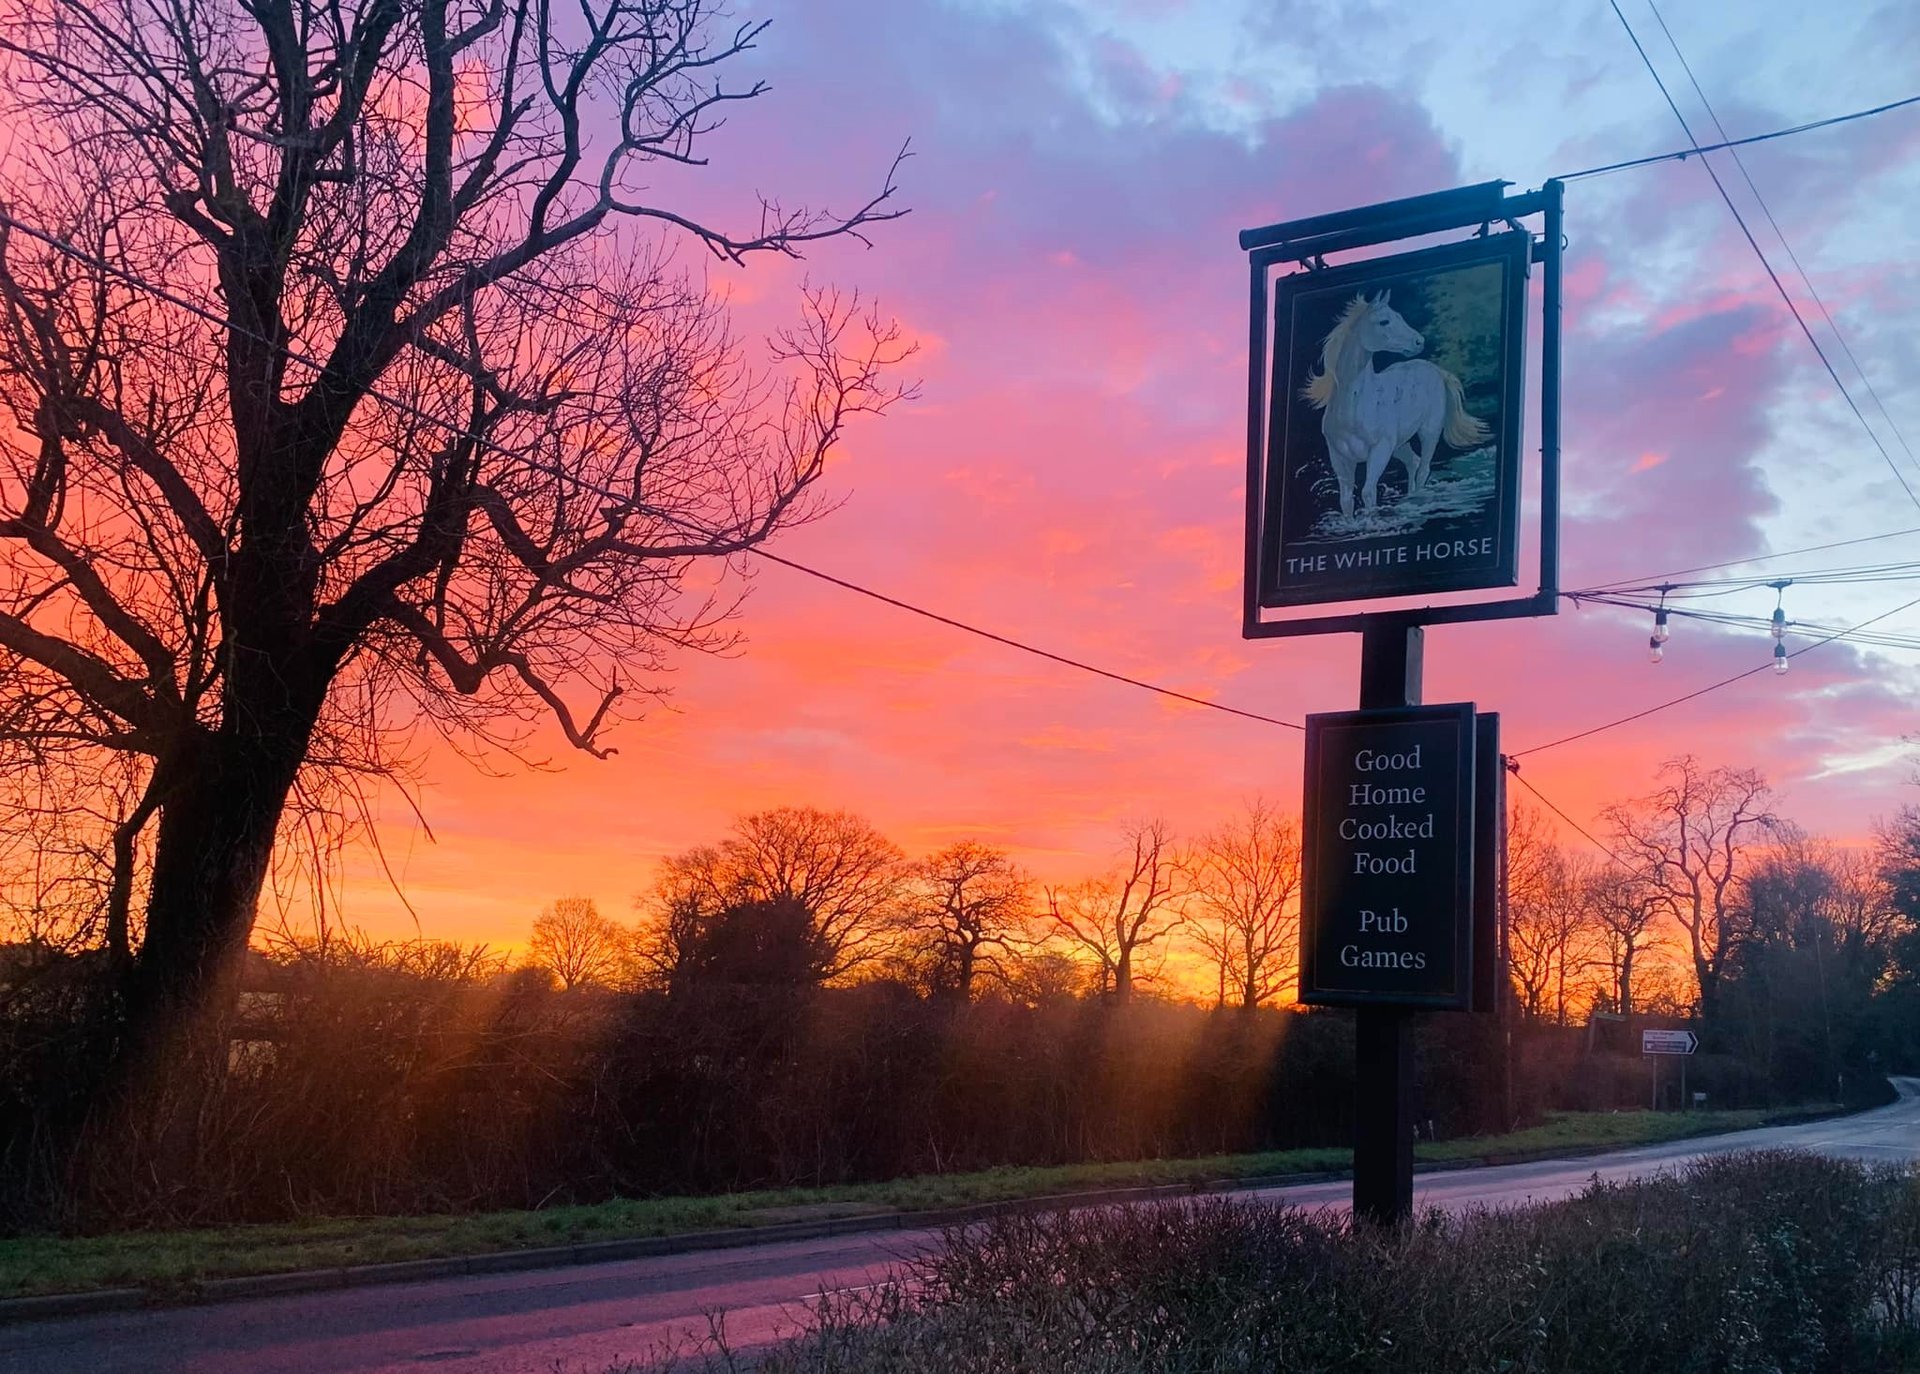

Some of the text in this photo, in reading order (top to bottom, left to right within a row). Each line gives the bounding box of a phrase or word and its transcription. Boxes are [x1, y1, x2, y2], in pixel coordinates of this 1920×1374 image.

[1286, 537, 1492, 574] THE WHITE HORSE
[1355, 745, 1422, 772] Good
[1348, 784, 1426, 805] Home
[1339, 814, 1434, 840] Cooked
[1353, 849, 1416, 874] Food
[1359, 908, 1408, 933] Pub
[1341, 945, 1426, 969] Games
